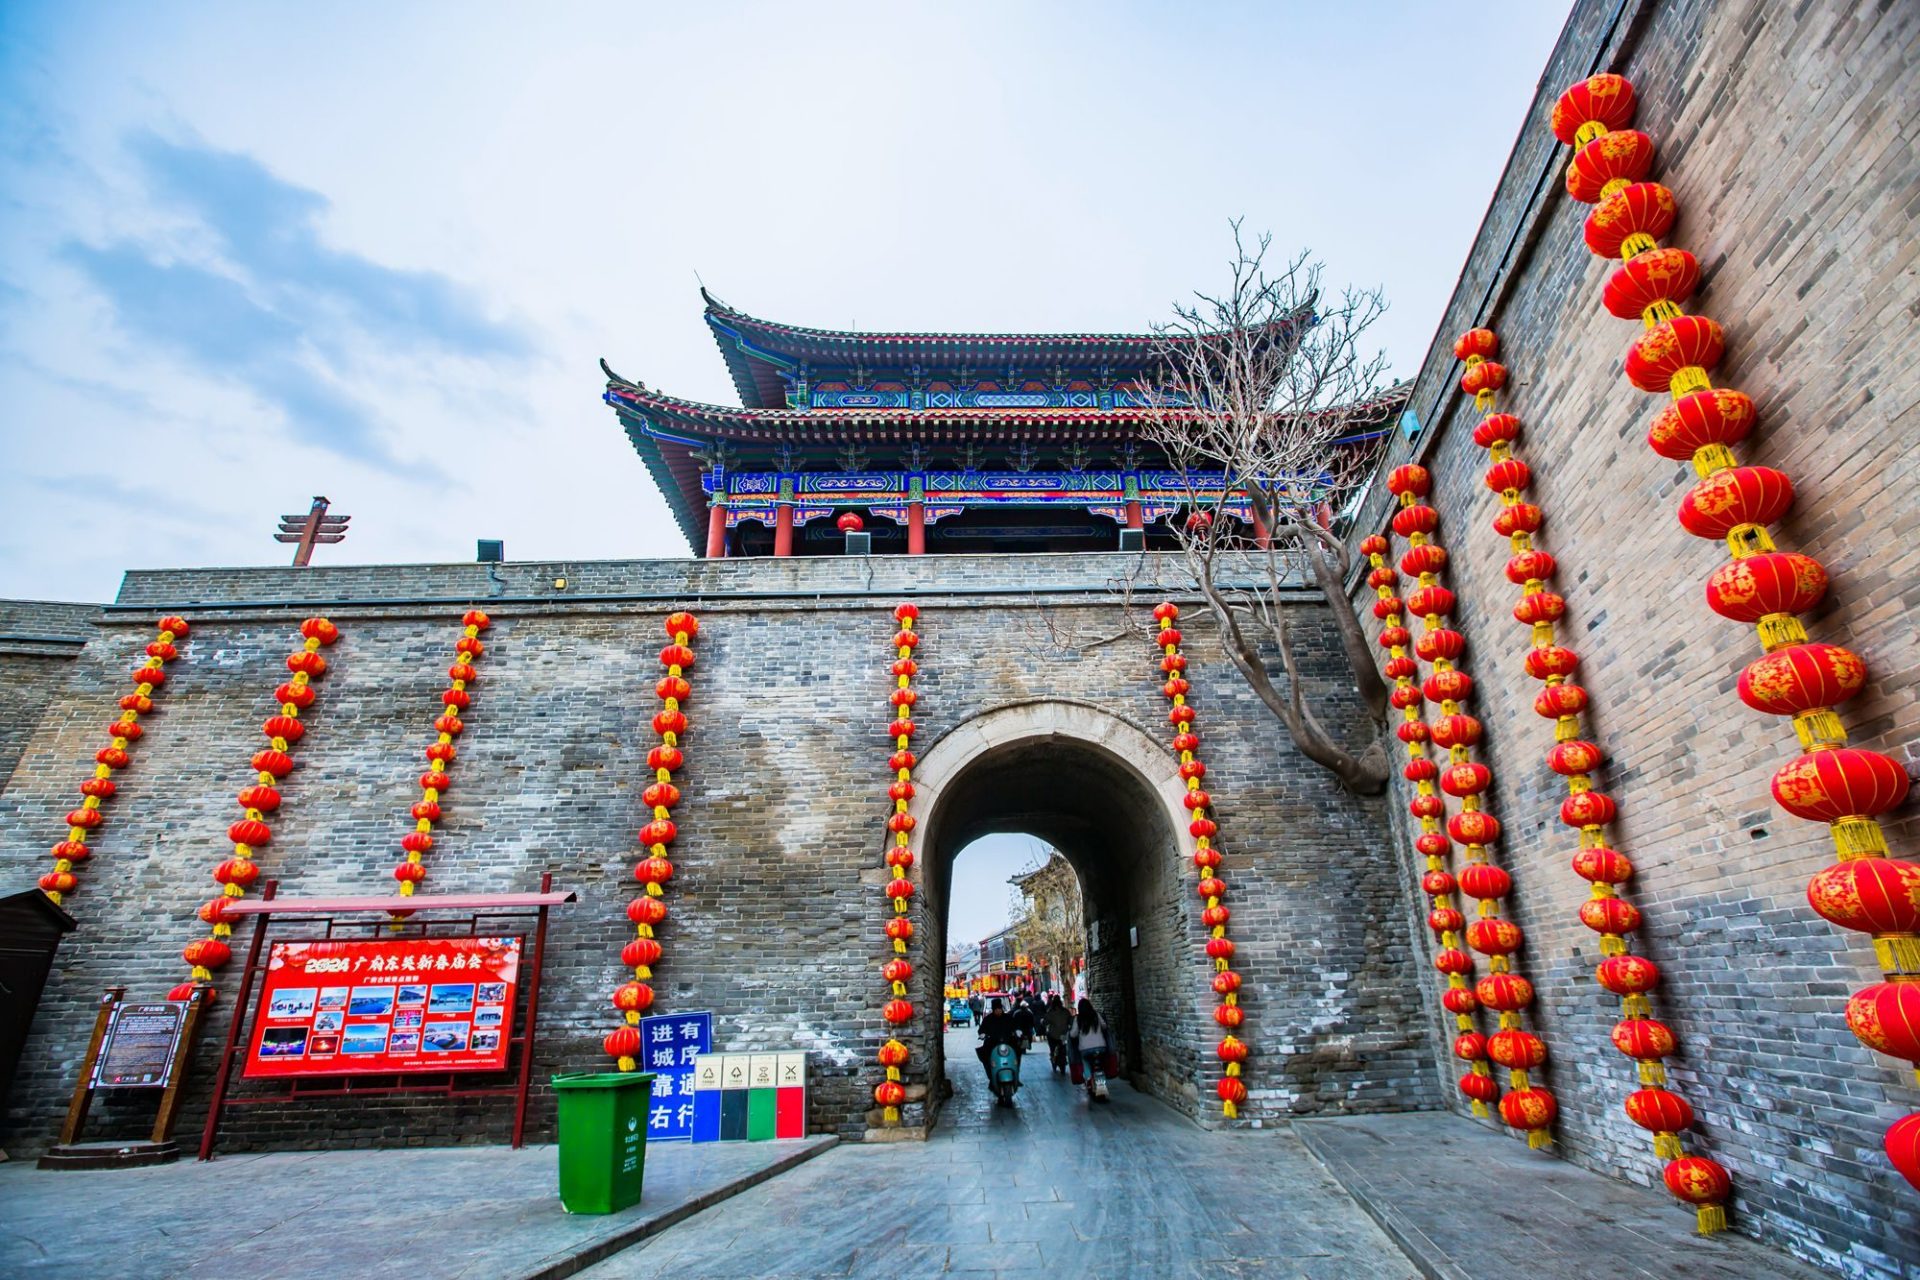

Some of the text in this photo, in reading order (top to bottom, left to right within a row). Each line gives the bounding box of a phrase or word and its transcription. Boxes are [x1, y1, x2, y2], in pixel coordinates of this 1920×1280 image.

[650, 1024, 675, 1129] 进城靠右
[677, 1022, 701, 1128] 有序通行
